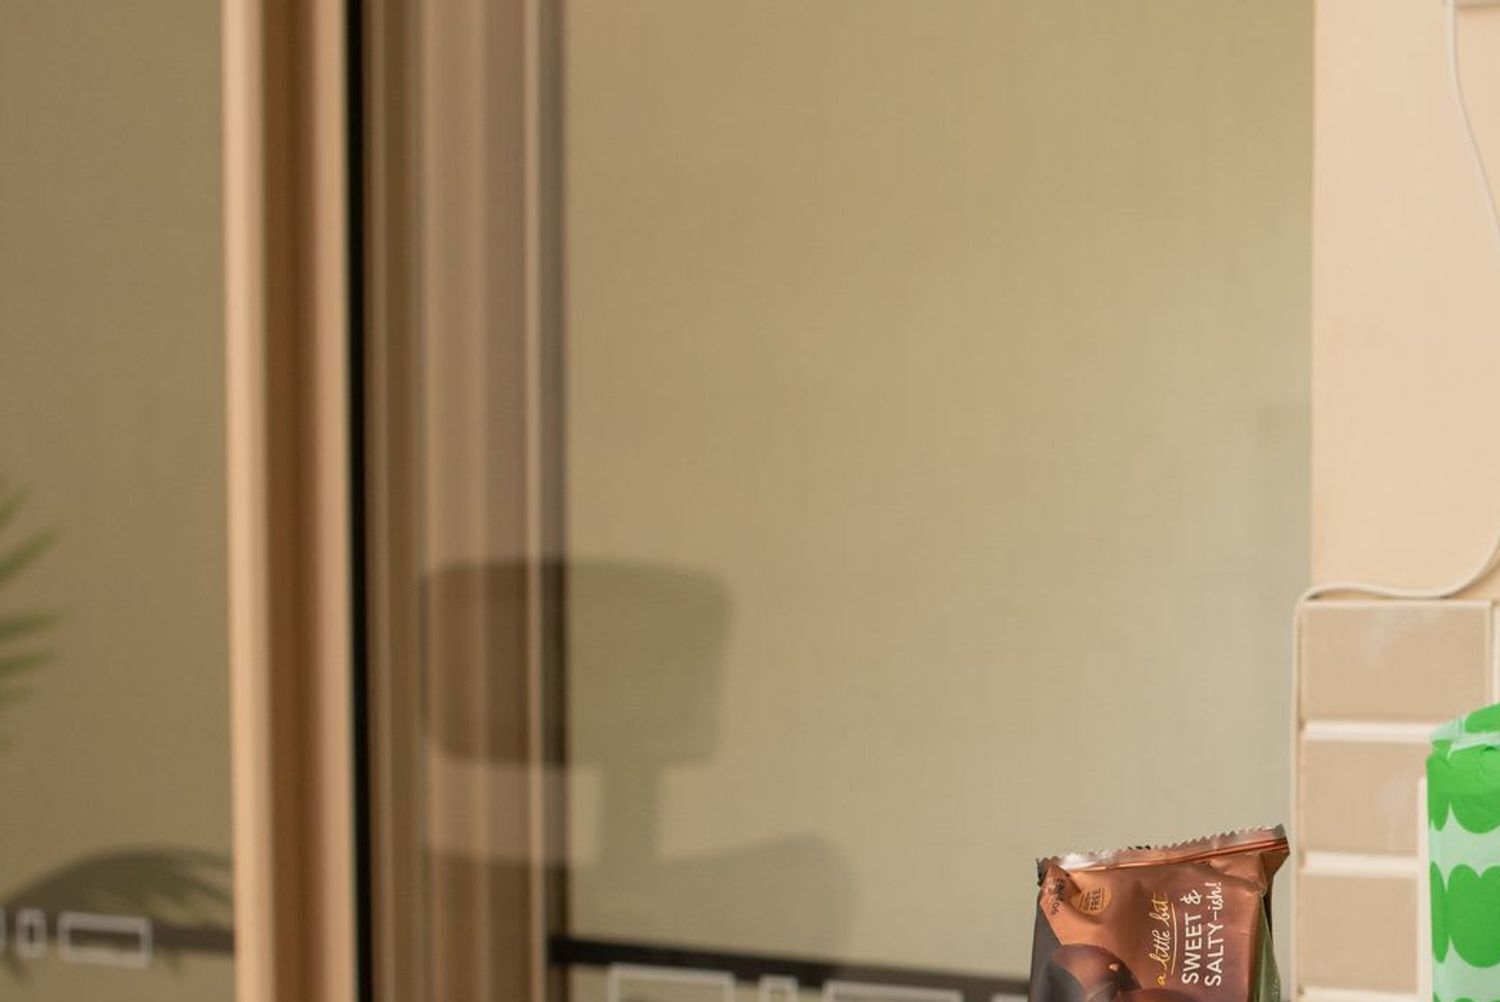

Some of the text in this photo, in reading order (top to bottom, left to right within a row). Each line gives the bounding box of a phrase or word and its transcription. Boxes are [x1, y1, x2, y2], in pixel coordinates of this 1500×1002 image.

[1148, 892, 1171, 985] a little bit
[1179, 889, 1202, 984] SWEET &
